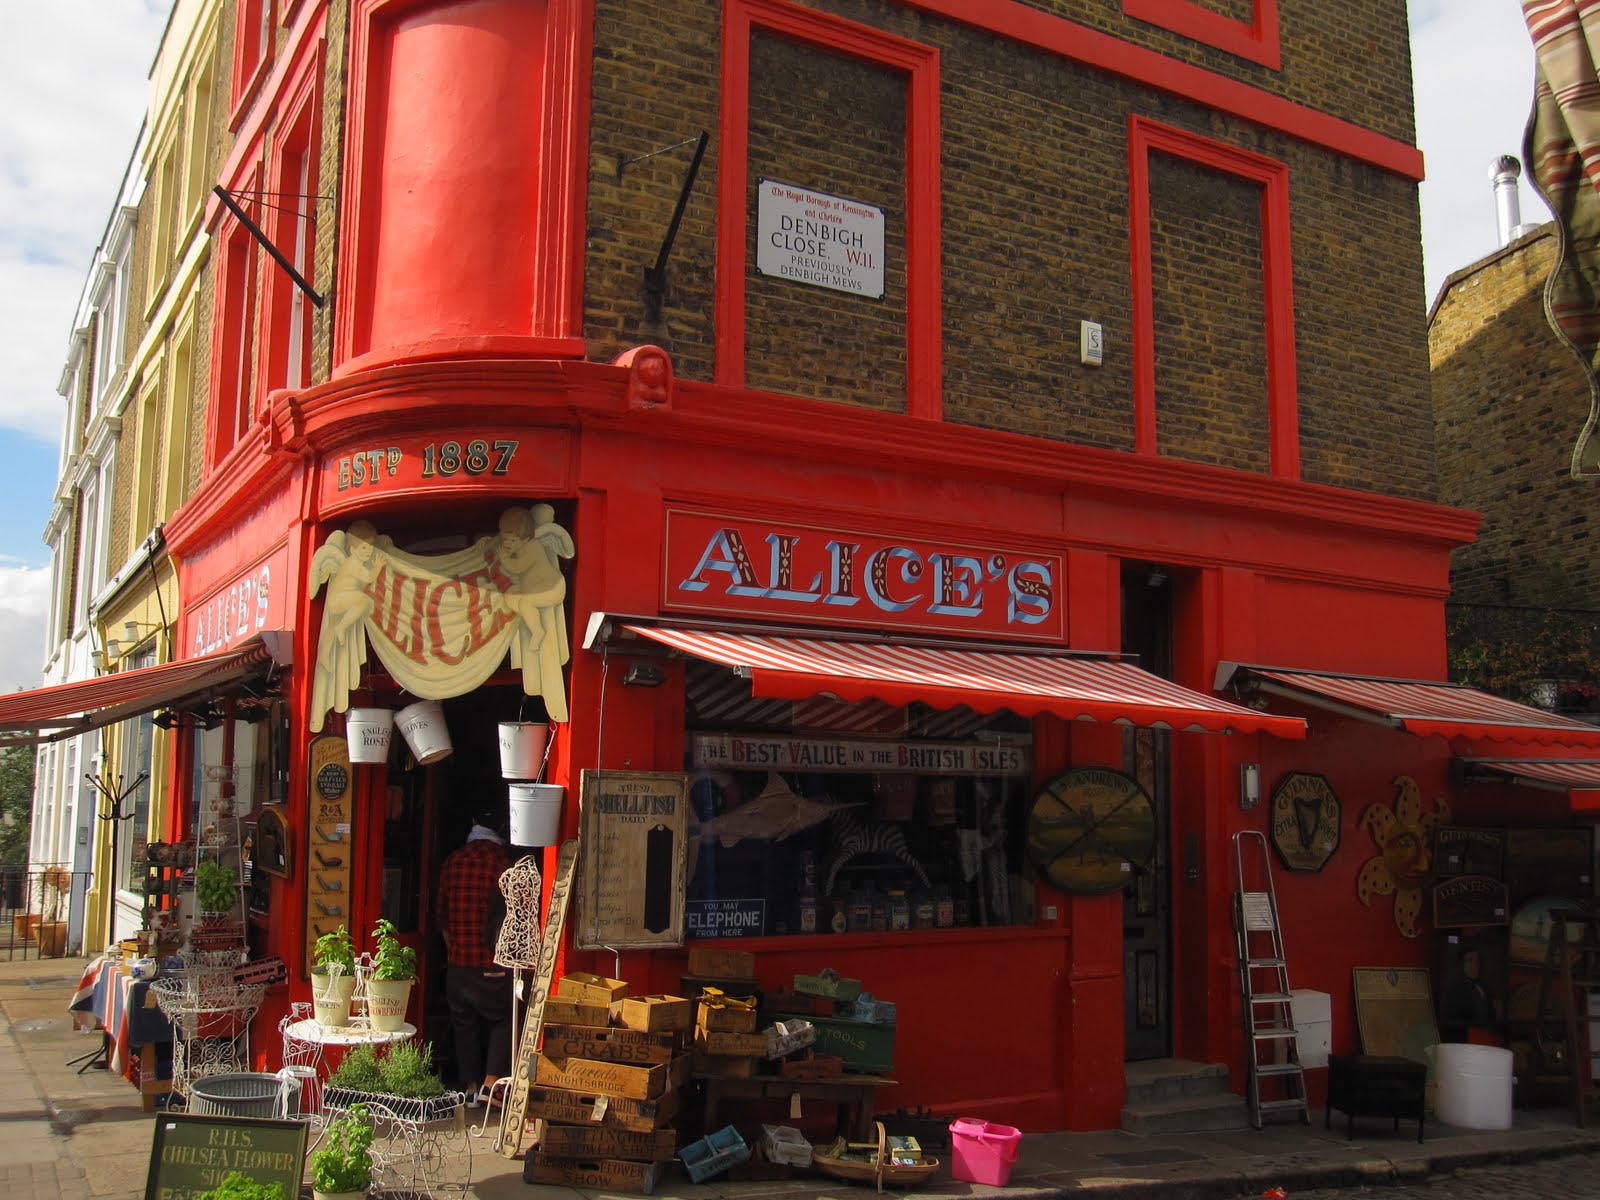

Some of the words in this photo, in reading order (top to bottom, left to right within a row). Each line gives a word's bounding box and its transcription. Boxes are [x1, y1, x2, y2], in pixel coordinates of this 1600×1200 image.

[771, 187, 784, 196] The
[786, 190, 804, 203] Royal
[806, 195, 831, 209] Borough
[842, 202, 875, 219] Kensington
[804, 209, 816, 218] and
[818, 211, 843, 224] Chelsea
[781, 215, 864, 249] DENBIGH
[791, 255, 853, 277] PREVIOUSLY
[780, 265, 829, 284] DENBIGH
[832, 275, 862, 290] MEWS
[421, 440, 520, 479] 1887
[679, 527, 1054, 625] ALICE'S
[193, 565, 270, 658] ALICE'S
[363, 736, 390, 747] ROSES
[731, 739, 781, 765] BEST
[787, 742, 848, 766] VALUE
[852, 750, 864, 763] IN
[871, 750, 893, 764] THE
[898, 746, 965, 769] BRITISH
[971, 749, 1019, 769] ISLES
[621, 783, 651, 793] FRESH
[1278, 777, 1337, 818] GUINNESS
[593, 794, 675, 816] SHELLFISH
[621, 816, 646, 825] DAILY
[703, 902, 719, 911] YOU
[722, 901, 740, 910] MAY
[696, 929, 718, 938] FROM
[722, 928, 743, 937] HERE
[563, 1040, 651, 1061] CRABS
[826, 1028, 866, 1051] TOOLS
[502, 987, 546, 1148] PORTOBELLO
[546, 1073, 626, 1093] KNIGHTSBRIDGE
[543, 1089, 579, 1107] COVENT
[544, 1106, 589, 1121] FLOWER
[162, 1145, 230, 1167] CHELSEA
[234, 1150, 294, 1171] FLOWER
[600, 1160, 645, 1178] FLOWER
[564, 1173, 613, 1187] SHOW
